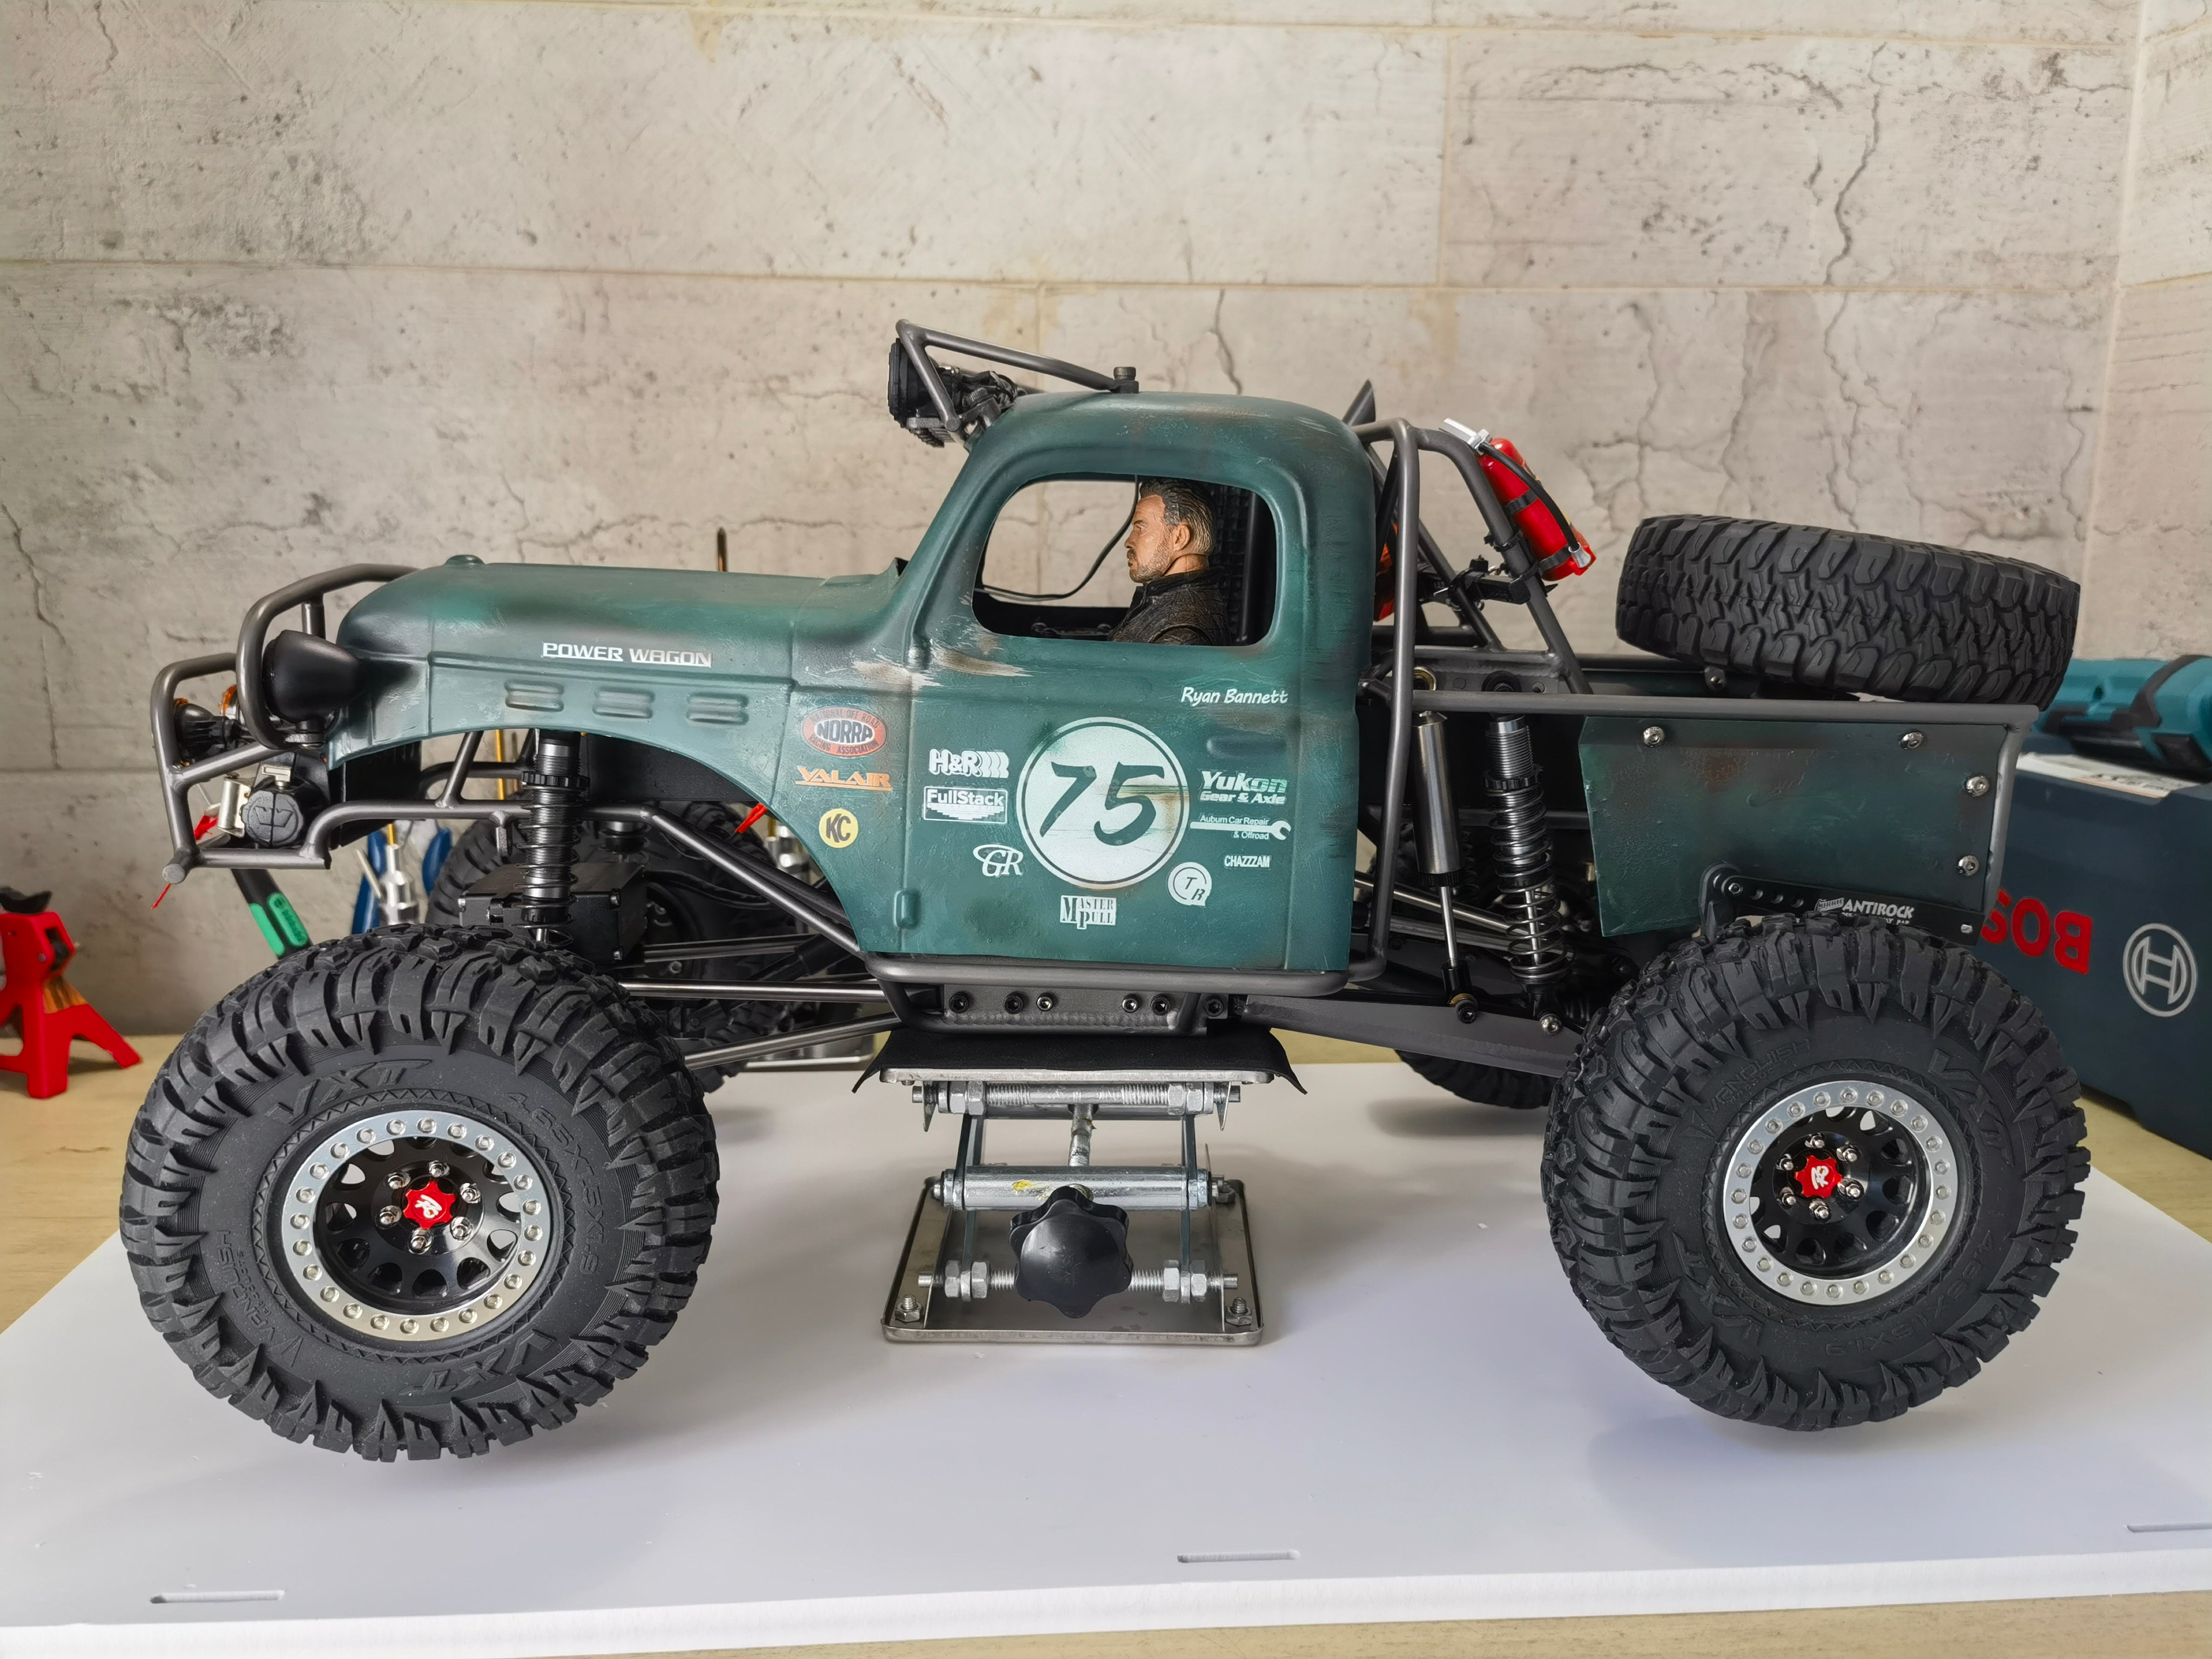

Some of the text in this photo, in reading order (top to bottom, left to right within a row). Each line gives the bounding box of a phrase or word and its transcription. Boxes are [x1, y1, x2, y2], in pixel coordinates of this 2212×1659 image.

[543, 643, 712, 667] POWER WAGON
[1181, 686, 1289, 706] Ryan Bannett
[847, 709, 859, 719] OFF
[861, 714, 880, 729] ROAD
[817, 720, 873, 744] NORRA
[808, 734, 880, 754] RACING ASSOCIATION
[930, 749, 984, 777] H&R
[797, 767, 891, 789] VALAIR
[1199, 770, 1288, 794] Yukon
[927, 789, 1004, 806] FullStack
[1040, 762, 1165, 846] 75
[1199, 792, 1285, 805] Gear & Axle
[825, 813, 852, 843] KC
[1229, 816, 1242, 824] Car
[1244, 817, 1269, 827] Repair
[1242, 831, 1269, 840] Offroad
[1224, 855, 1270, 868] CHAZZZAM
[1062, 896, 1115, 922] MASTER
[1077, 909, 1114, 928] PULL
[1842, 899, 1914, 919] ANTIROCK
[265, 1059, 433, 1126] VXT
[217, 1229, 275, 1341] VANQUISH
[399, 1330, 555, 1397] VXT
